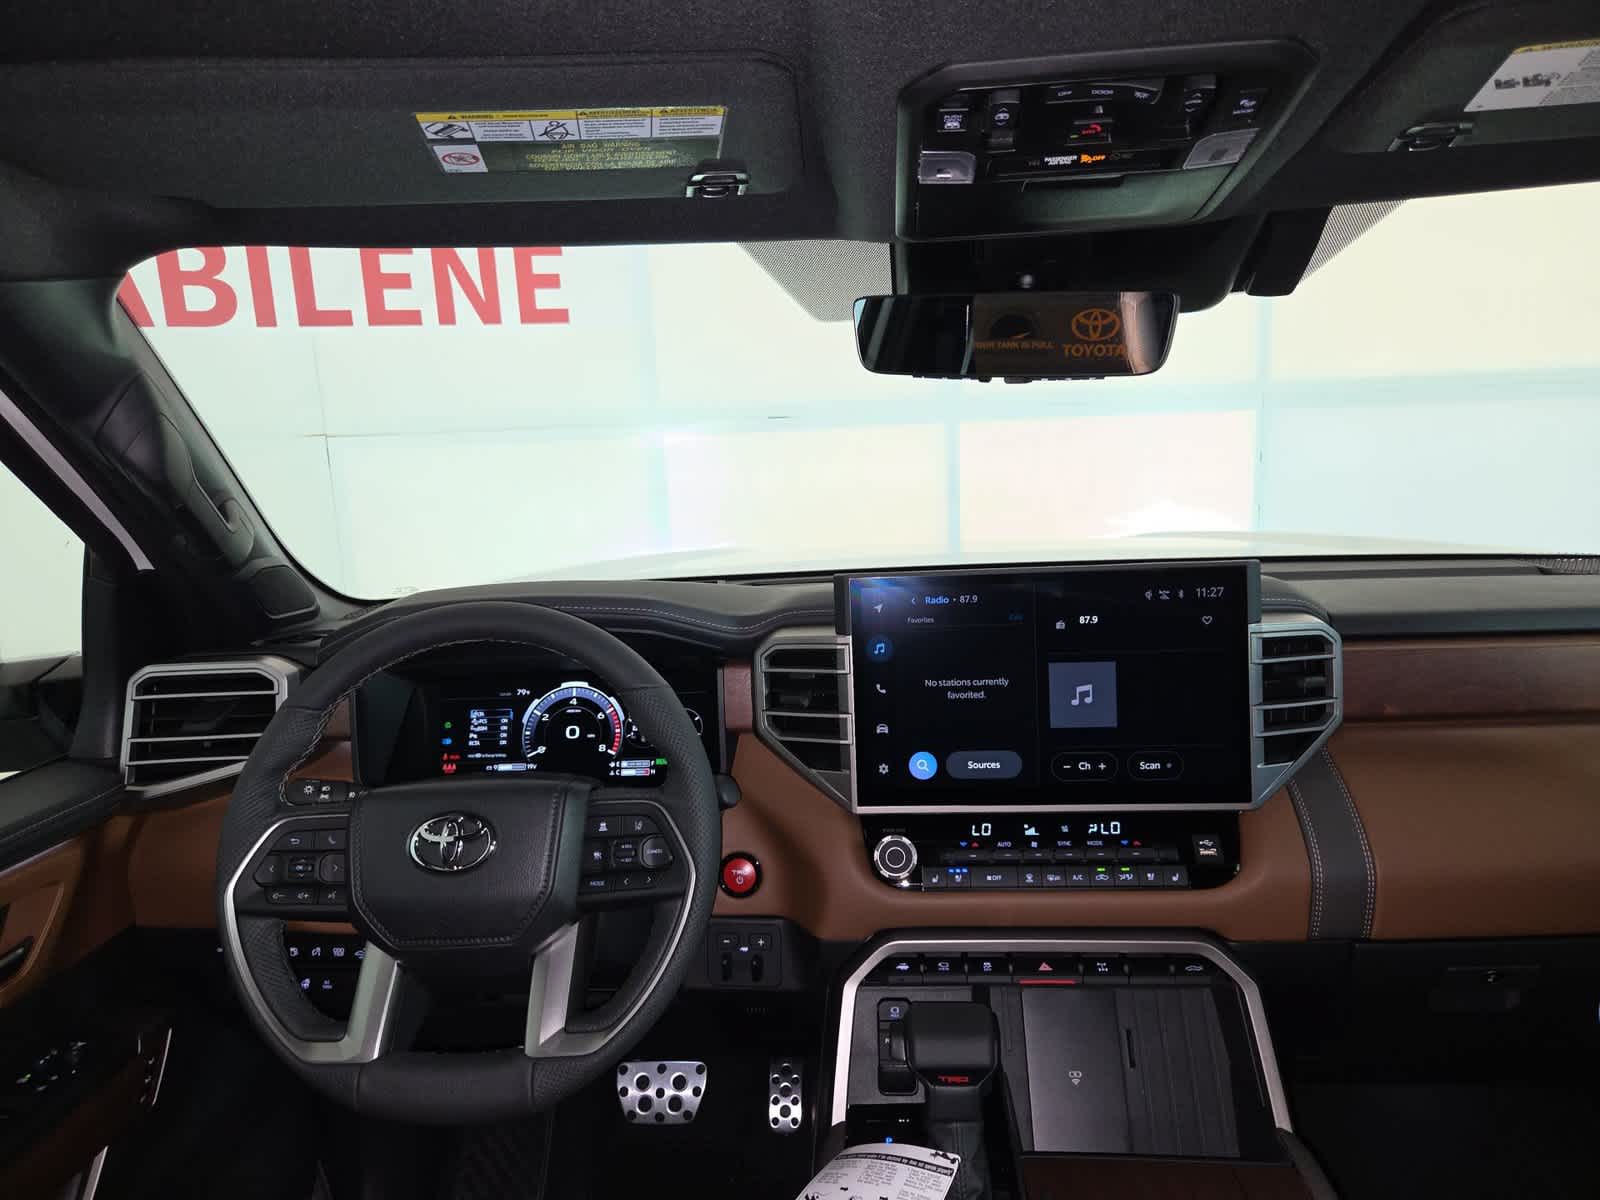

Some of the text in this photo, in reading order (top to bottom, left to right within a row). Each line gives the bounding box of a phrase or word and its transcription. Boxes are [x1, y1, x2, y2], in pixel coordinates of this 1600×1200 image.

[1063, 343, 1127, 358] TOYOTA
[1196, 586, 1224, 599] 11:27
[924, 594, 978, 605] Radio 87.9
[907, 615, 935, 624] Favorites
[1079, 615, 1099, 625] 87.9
[924, 676, 1009, 688] No stations currently
[947, 690, 986, 700] favorited.
[568, 698, 578, 706] 4
[541, 713, 550, 721] 2
[597, 712, 606, 720] 6
[565, 725, 581, 740] 0
[598, 743, 607, 753] 8
[967, 760, 1001, 770] Sources
[1078, 760, 1091, 770] Ch
[1139, 760, 1161, 770] Scan
[970, 822, 993, 837] LO
[1100, 821, 1121, 836] LO
[991, 874, 1004, 882] OFF
[1072, 874, 1085, 882] A/C
